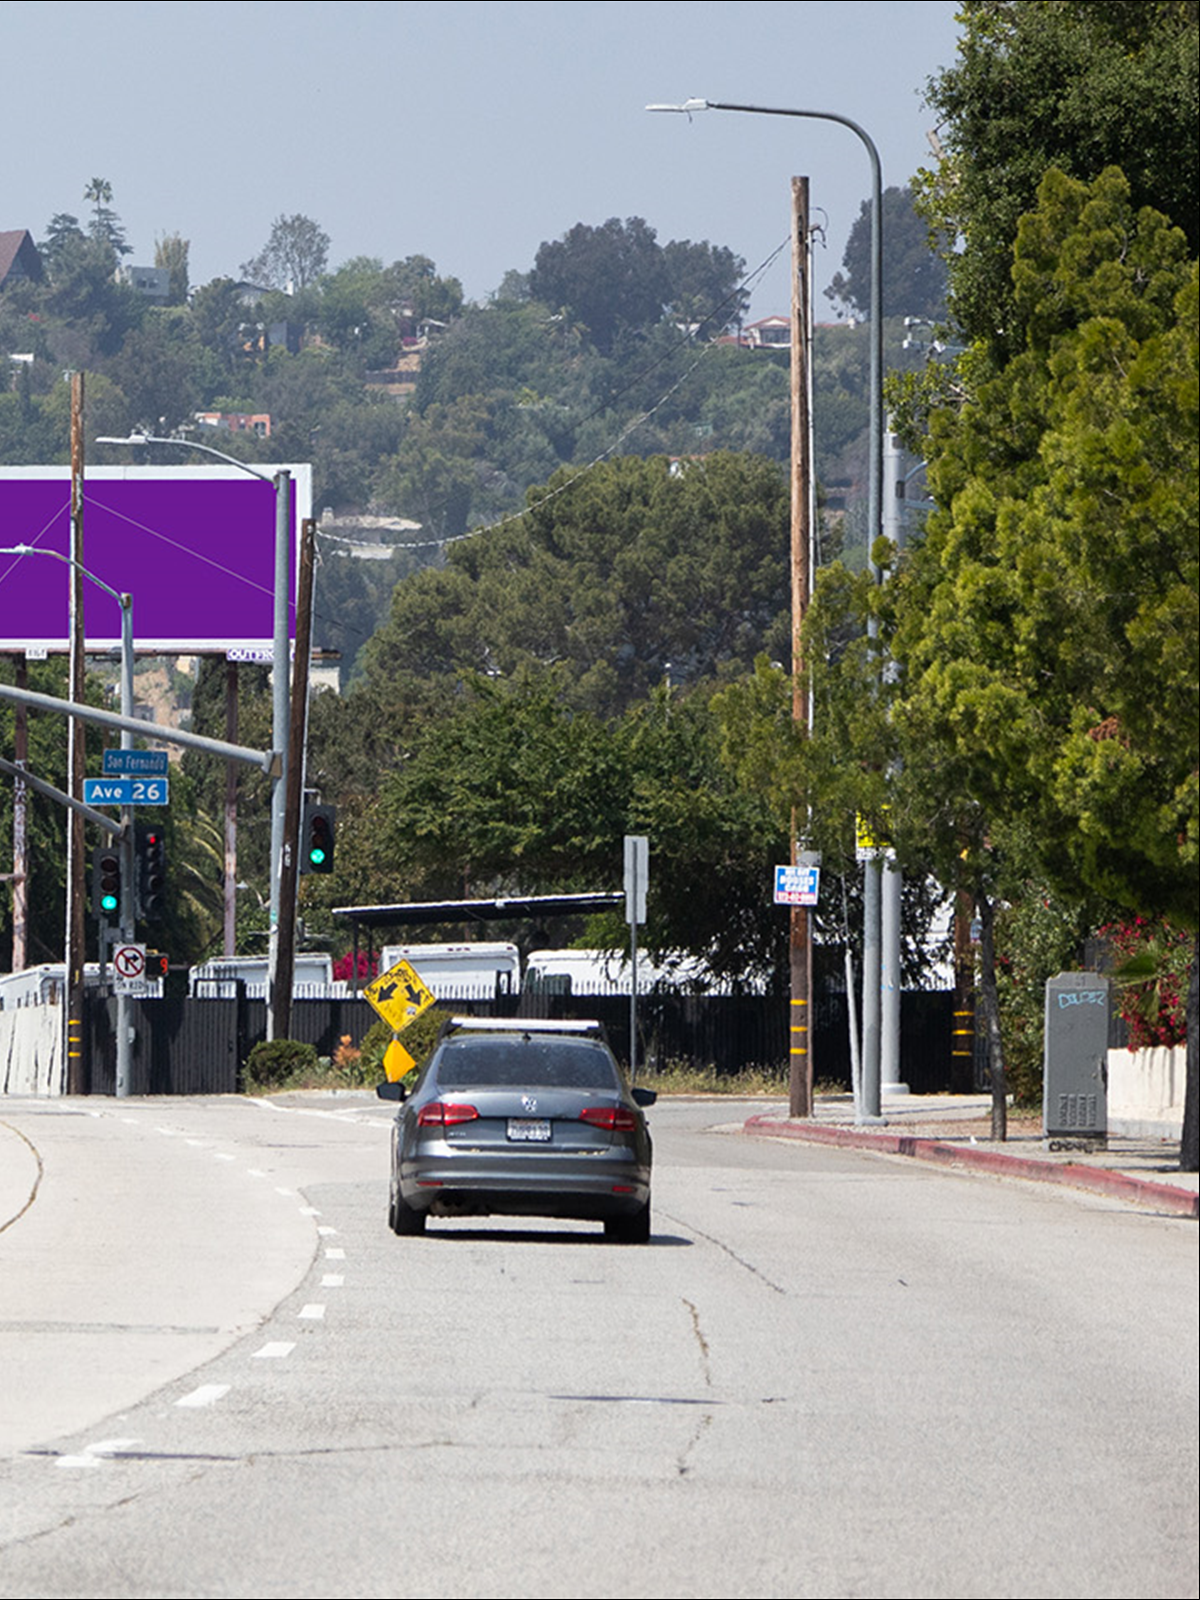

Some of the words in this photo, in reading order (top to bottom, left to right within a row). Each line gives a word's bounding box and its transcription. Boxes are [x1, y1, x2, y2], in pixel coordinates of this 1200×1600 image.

[107, 755, 123, 769] San
[91, 784, 123, 799] Ave
[132, 783, 160, 801] 26
[160, 957, 168, 974] 9
